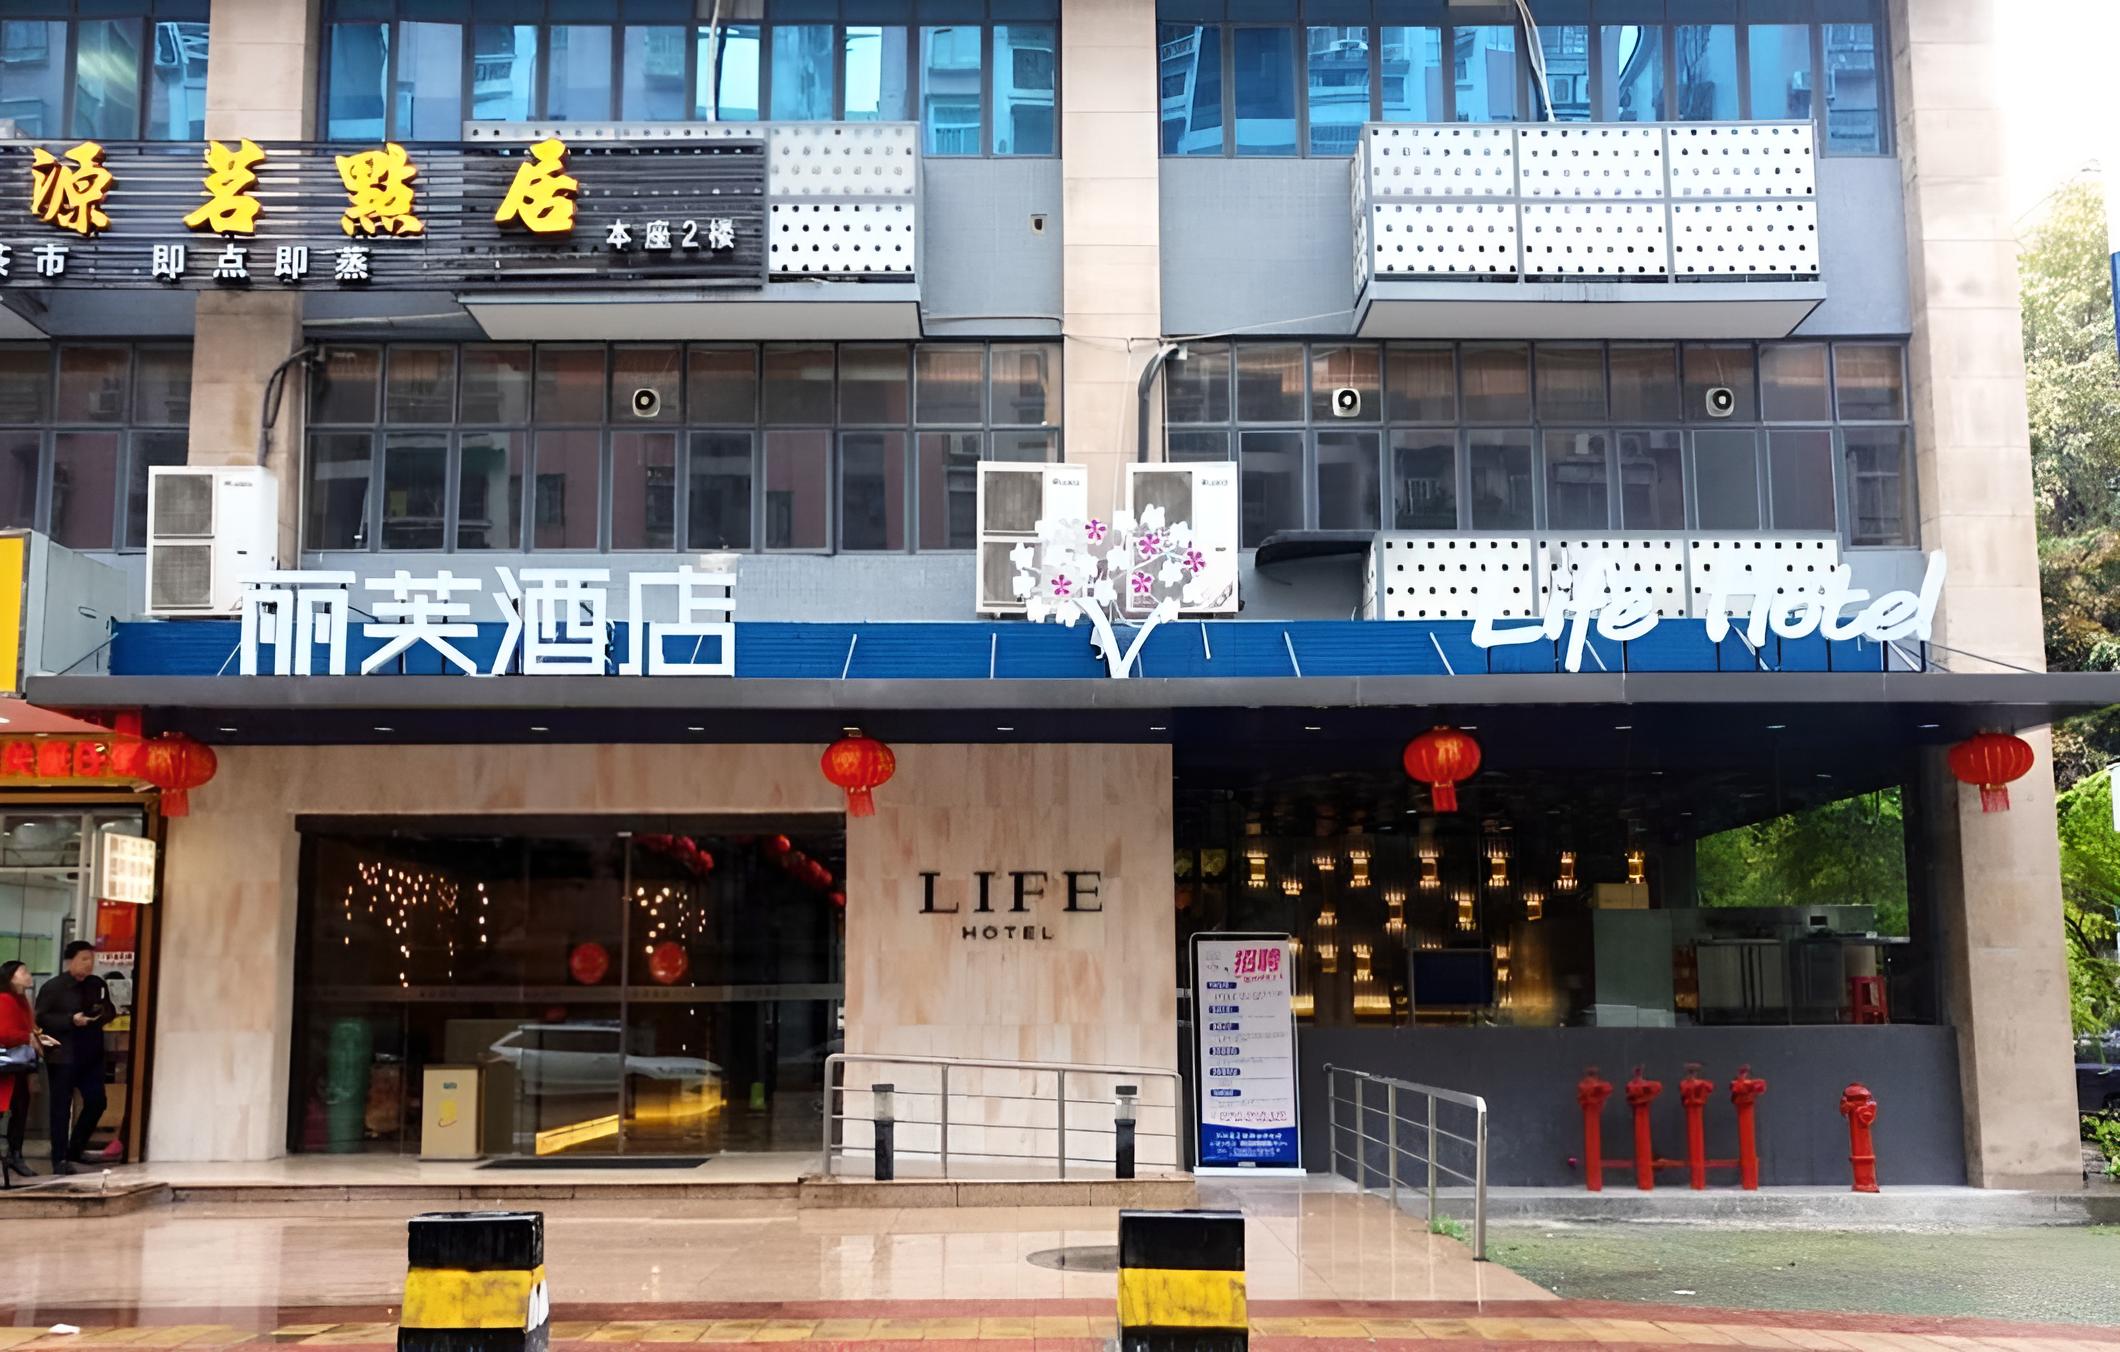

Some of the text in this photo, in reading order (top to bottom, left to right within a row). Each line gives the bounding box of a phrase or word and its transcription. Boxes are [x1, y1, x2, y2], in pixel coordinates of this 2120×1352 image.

[152, 244, 371, 280] 即点即蒸
[237, 565, 736, 676] 丽芙酒店
[1472, 550, 1947, 672] Life Hotel
[919, 871, 1102, 914] LIFE
[962, 925, 1053, 940] HOTEL
